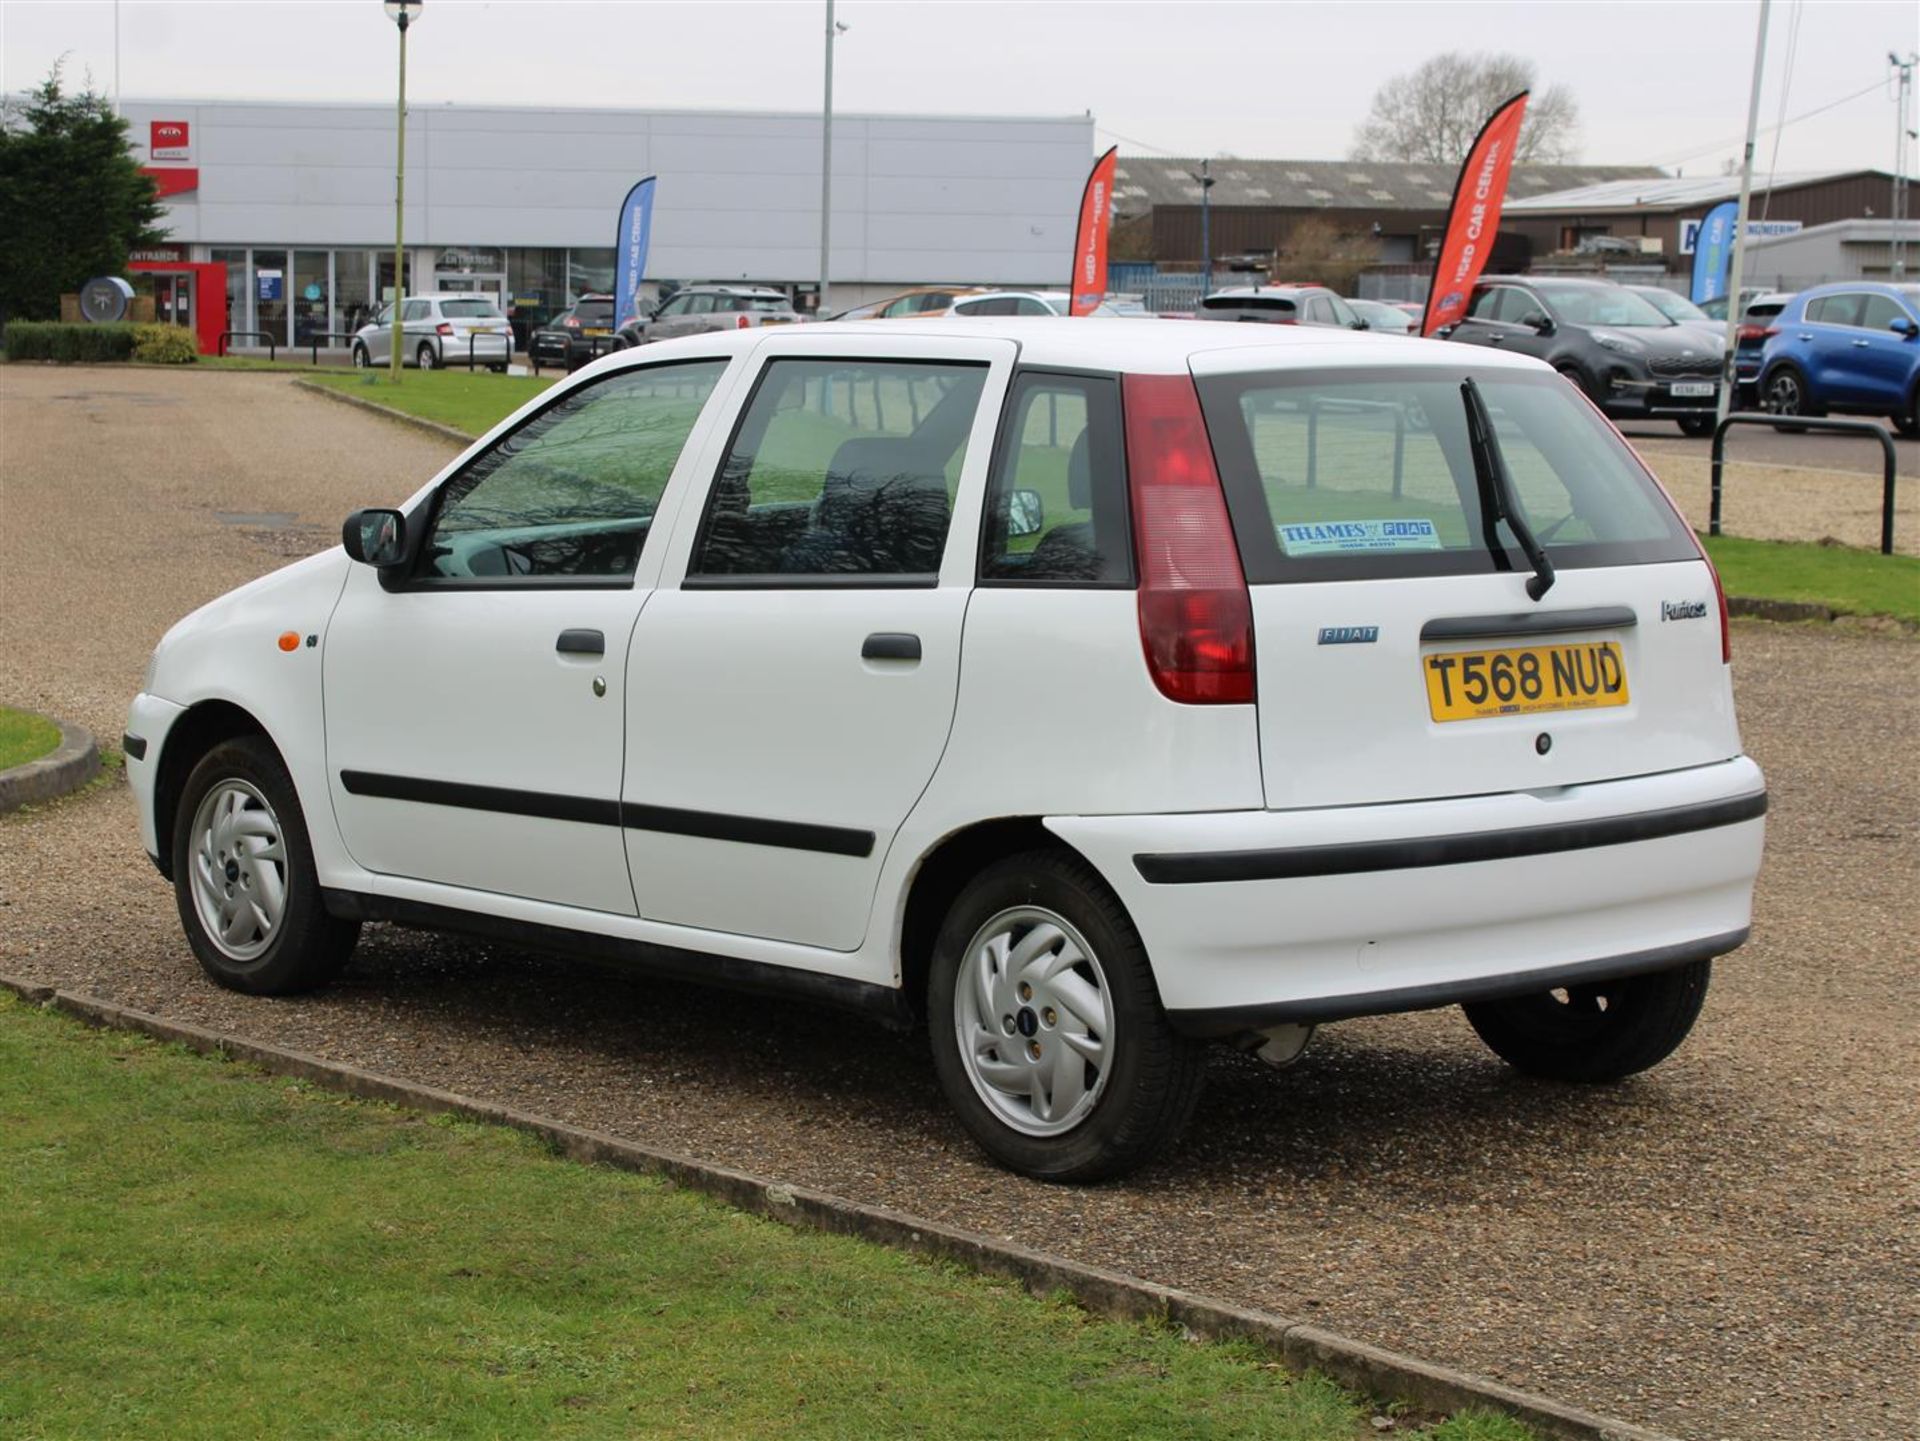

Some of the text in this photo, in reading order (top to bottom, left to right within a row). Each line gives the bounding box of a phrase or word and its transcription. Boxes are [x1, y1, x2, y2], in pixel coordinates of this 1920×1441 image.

[1466, 203, 1487, 241] CAR
[1282, 523, 1367, 542] THAMES
[1383, 521, 1432, 536] FIAT
[1318, 627, 1379, 644] FIAT
[1429, 646, 1622, 707] T568 NUD
